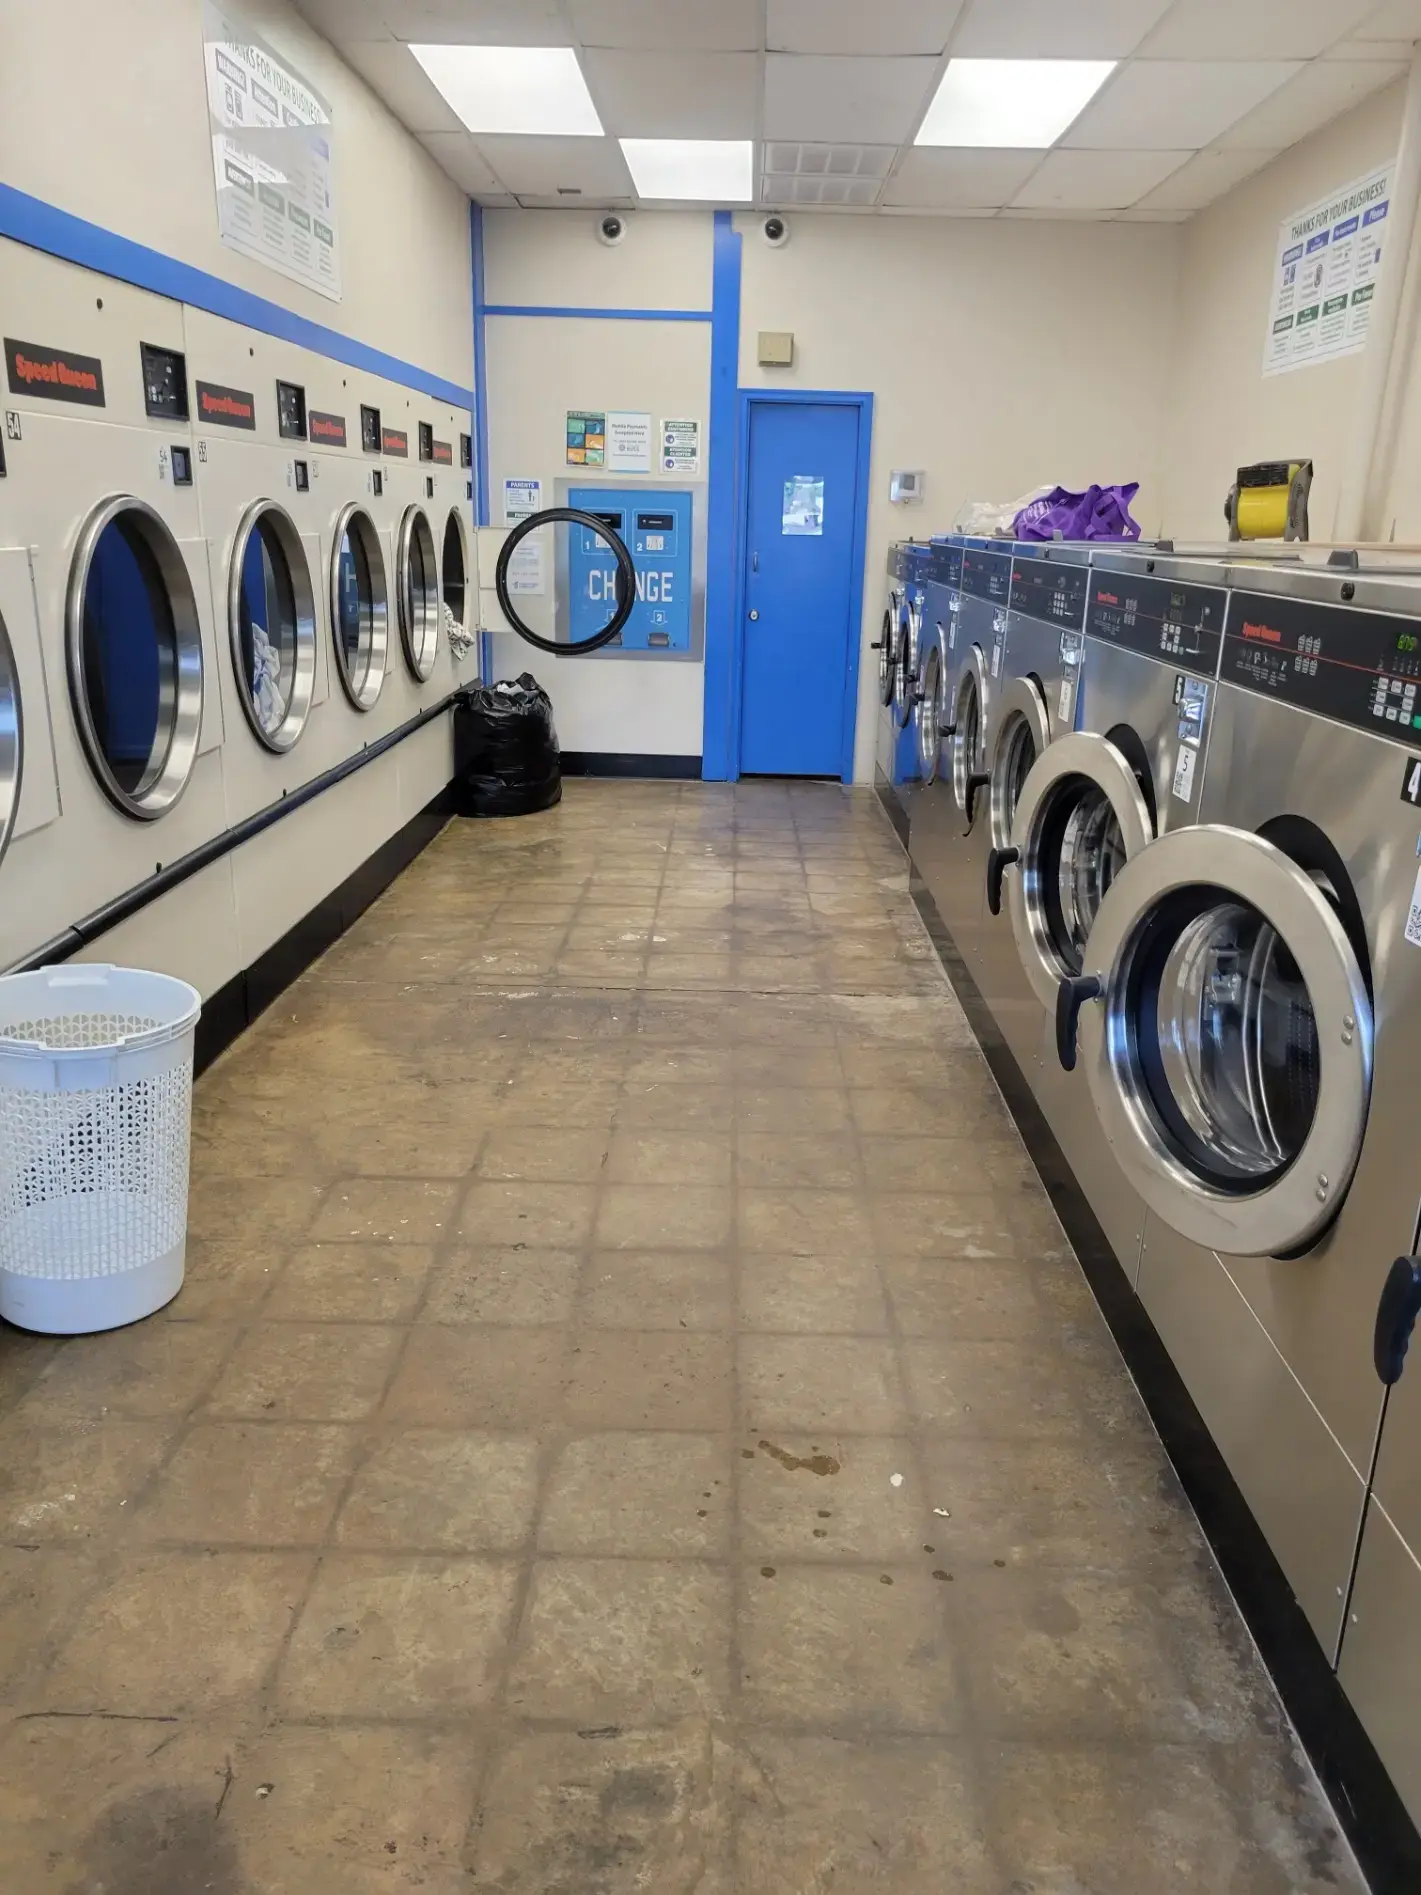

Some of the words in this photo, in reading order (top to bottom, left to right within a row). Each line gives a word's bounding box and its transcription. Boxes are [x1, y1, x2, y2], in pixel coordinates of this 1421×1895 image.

[1291, 215, 1316, 240] THANKS
[1315, 208, 1329, 228] FOR
[1328, 199, 1349, 223] YOUR
[15, 352, 58, 384] Speed
[58, 361, 97, 390] Queen
[637, 543, 642, 552] 2
[588, 569, 673, 602] CHNGE
[656, 613, 662, 622] 2
